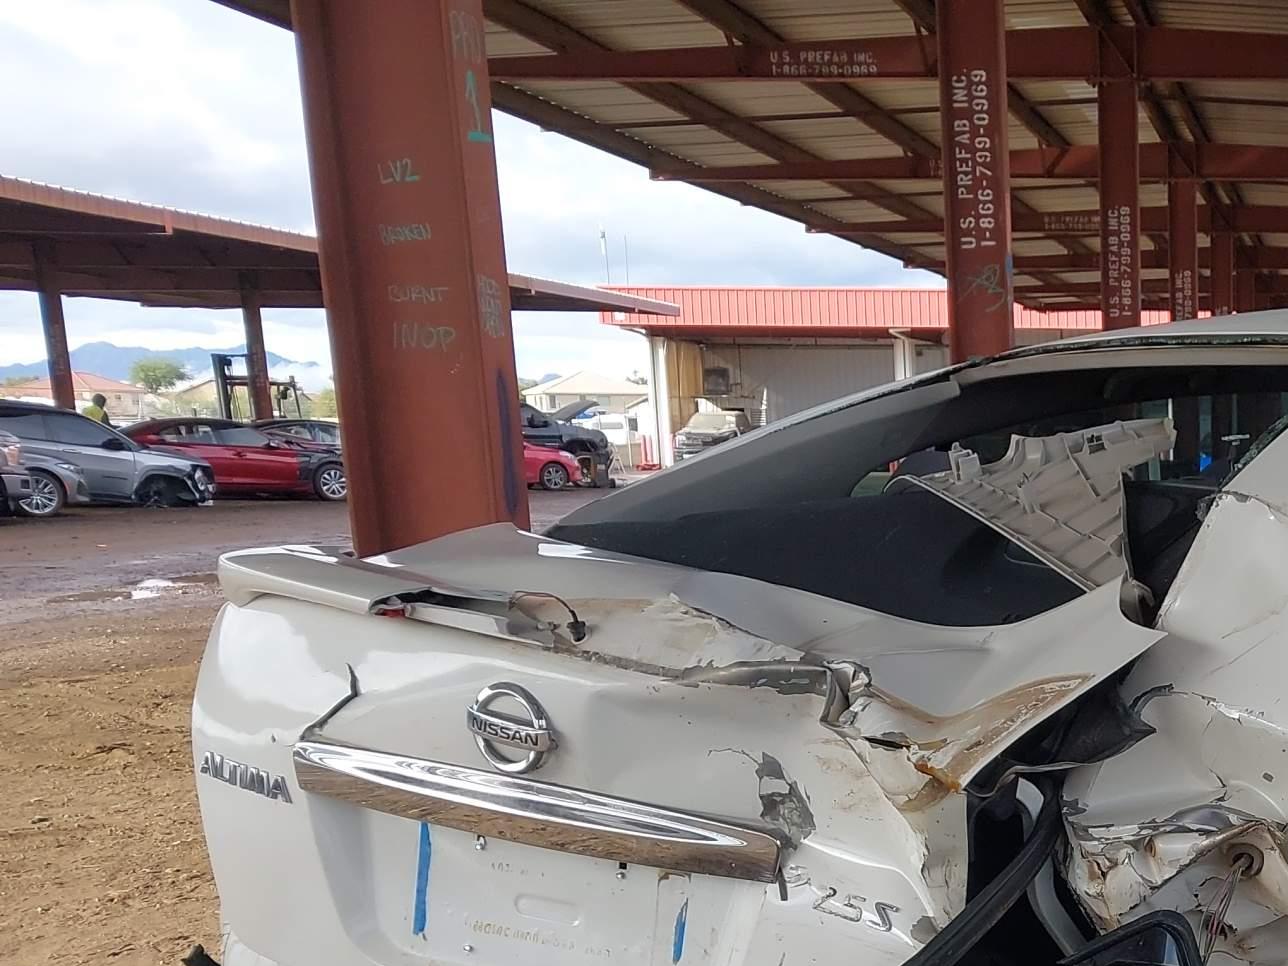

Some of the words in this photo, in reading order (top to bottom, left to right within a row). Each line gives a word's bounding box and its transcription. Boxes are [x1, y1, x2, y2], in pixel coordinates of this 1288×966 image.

[799, 50, 848, 63] PREFAB
[952, 68, 970, 108] INC.
[954, 119, 974, 199] PREFAB
[971, 69, 997, 247] 1-866-799-0969
[960, 210, 977, 249] U.S.
[1107, 205, 1119, 231] INC.
[1107, 236, 1119, 287] PREFAB
[1120, 206, 1133, 316] 1-866-799-0969
[1109, 293, 1121, 318] U.S.
[470, 716, 541, 748] NISSAN
[200, 751, 293, 804] ALTIMA
[865, 901, 900, 932] S
